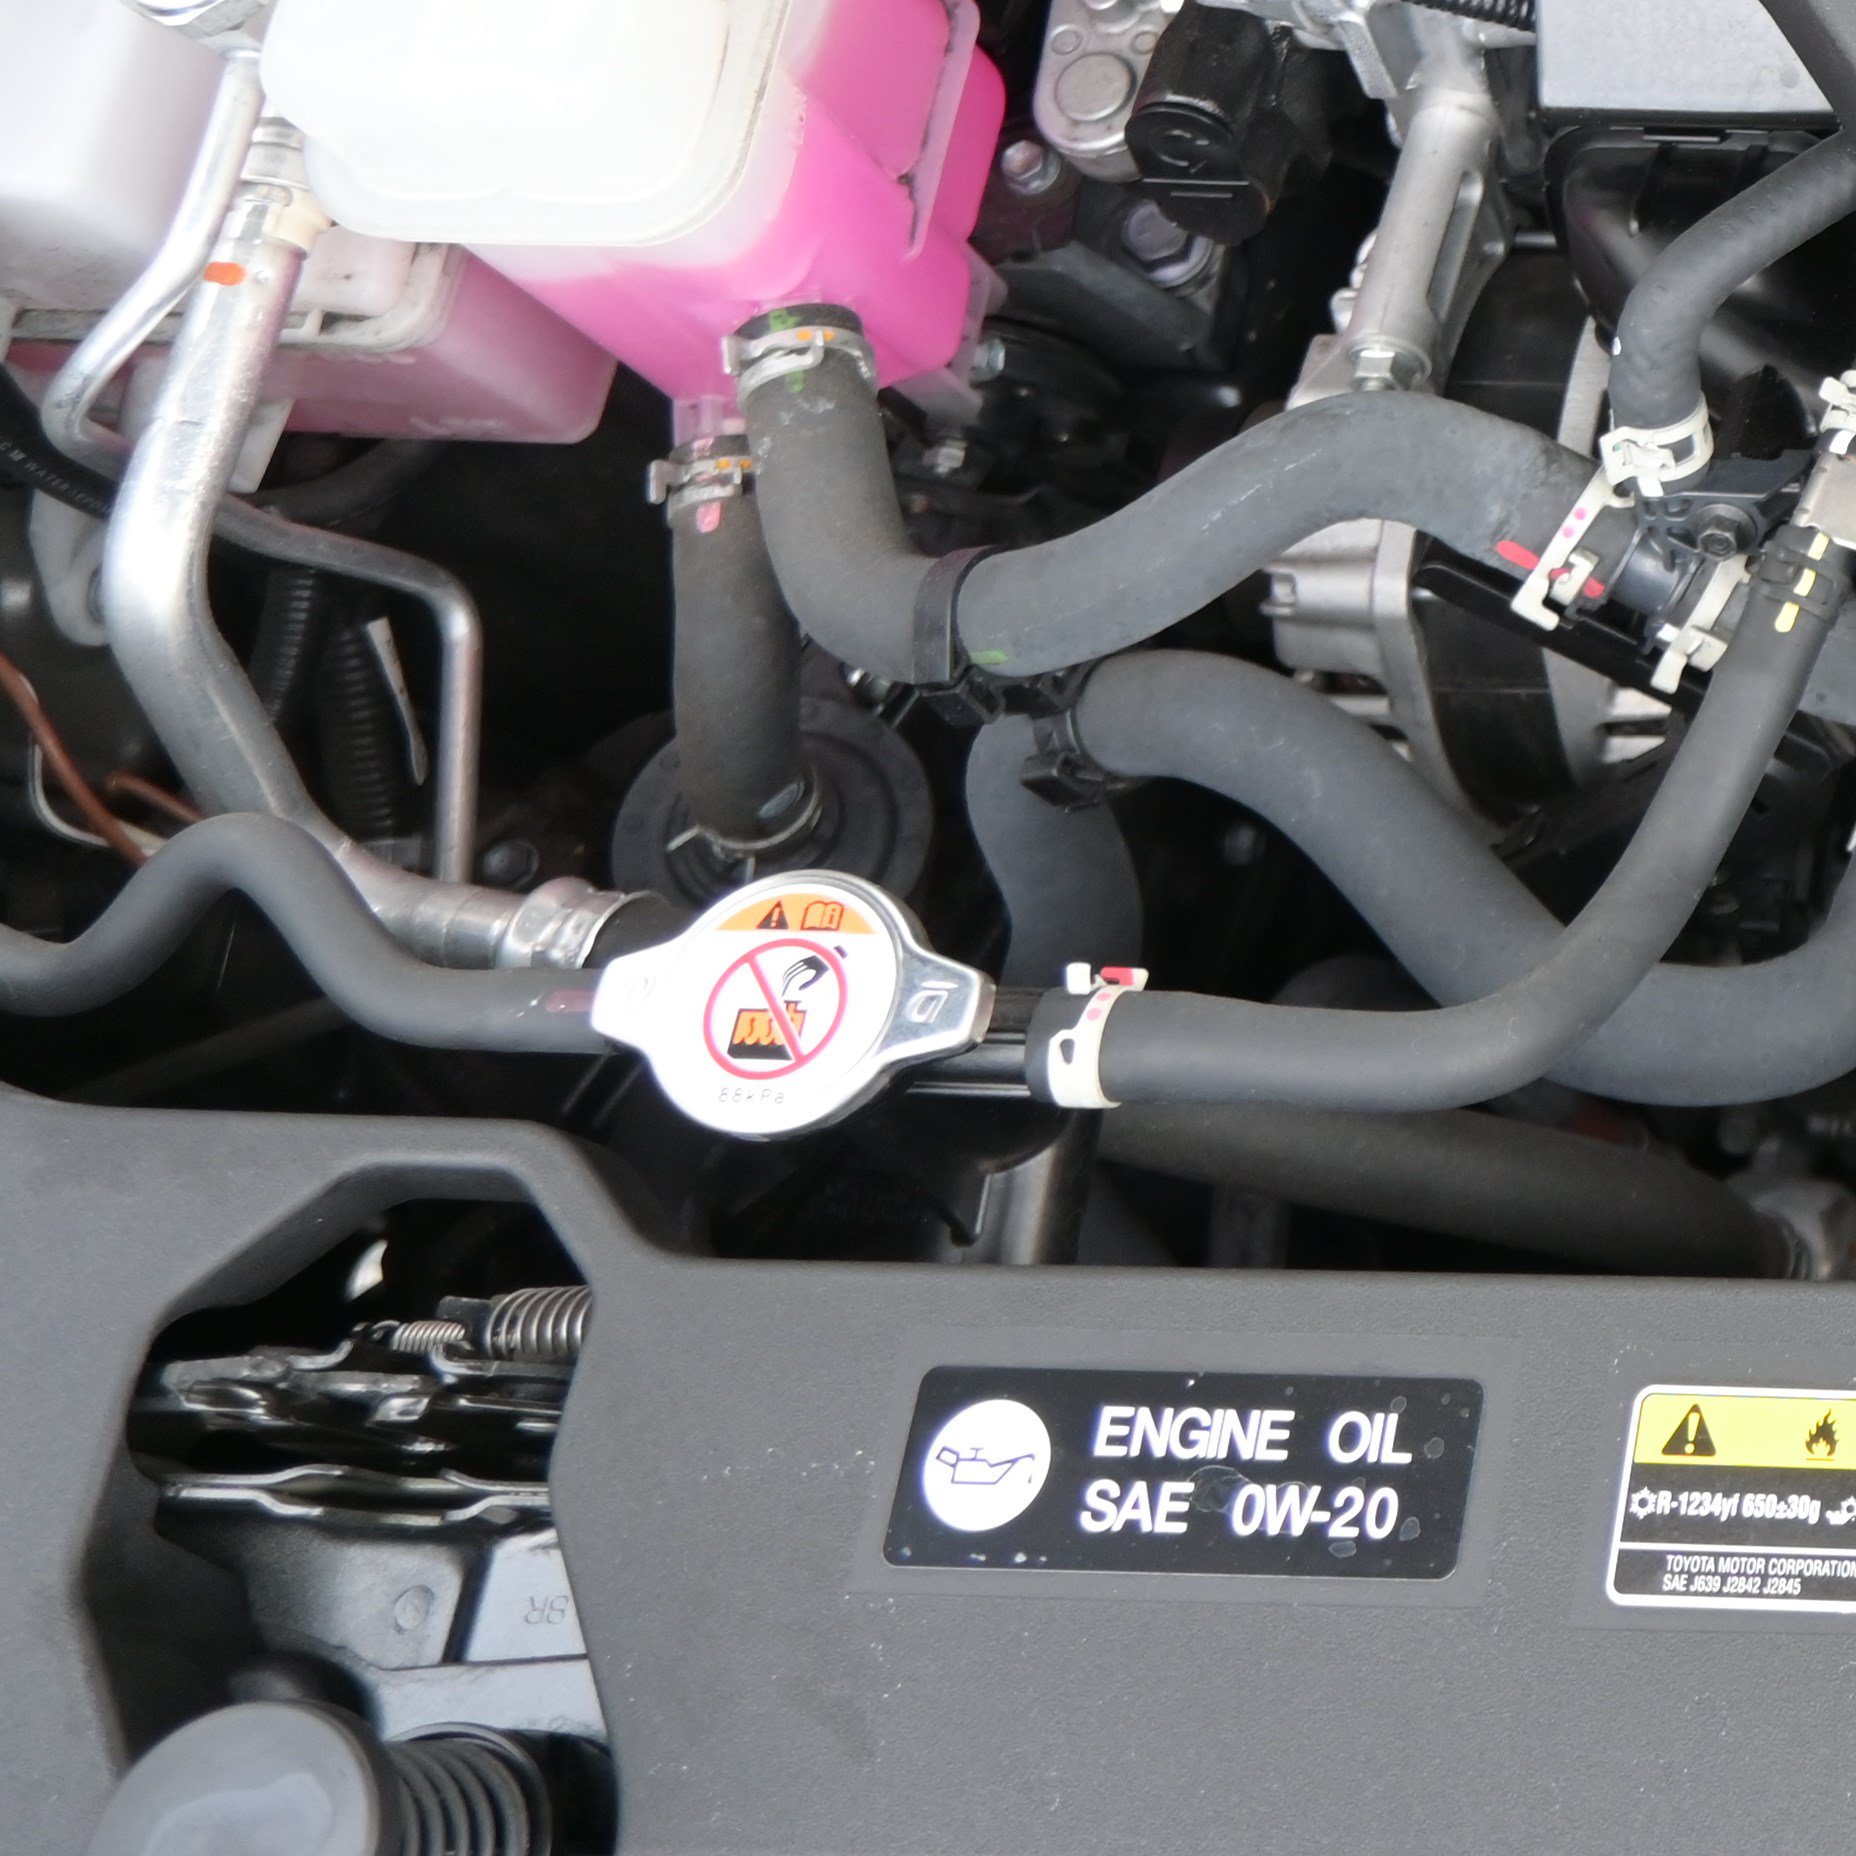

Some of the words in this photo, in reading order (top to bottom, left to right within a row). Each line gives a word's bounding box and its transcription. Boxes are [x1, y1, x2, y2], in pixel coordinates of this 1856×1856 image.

[718, 1087, 785, 1104] 88kPa
[1092, 1405, 1295, 1460] ENGINE
[1327, 1411, 1413, 1465] OIL
[1079, 1479, 1196, 1534] SAE
[1230, 1486, 1400, 1540] 0W-20
[1657, 1490, 1738, 1523] R-1234yf
[1666, 1554, 1716, 1573] TOYOTA
[1718, 1556, 1766, 1576] MOTOR
[1662, 1574, 1689, 1593] SAE
[1691, 1573, 1721, 1594] J639
[1722, 1575, 1761, 1595] J2842
[1763, 1577, 1802, 1597] J2845
